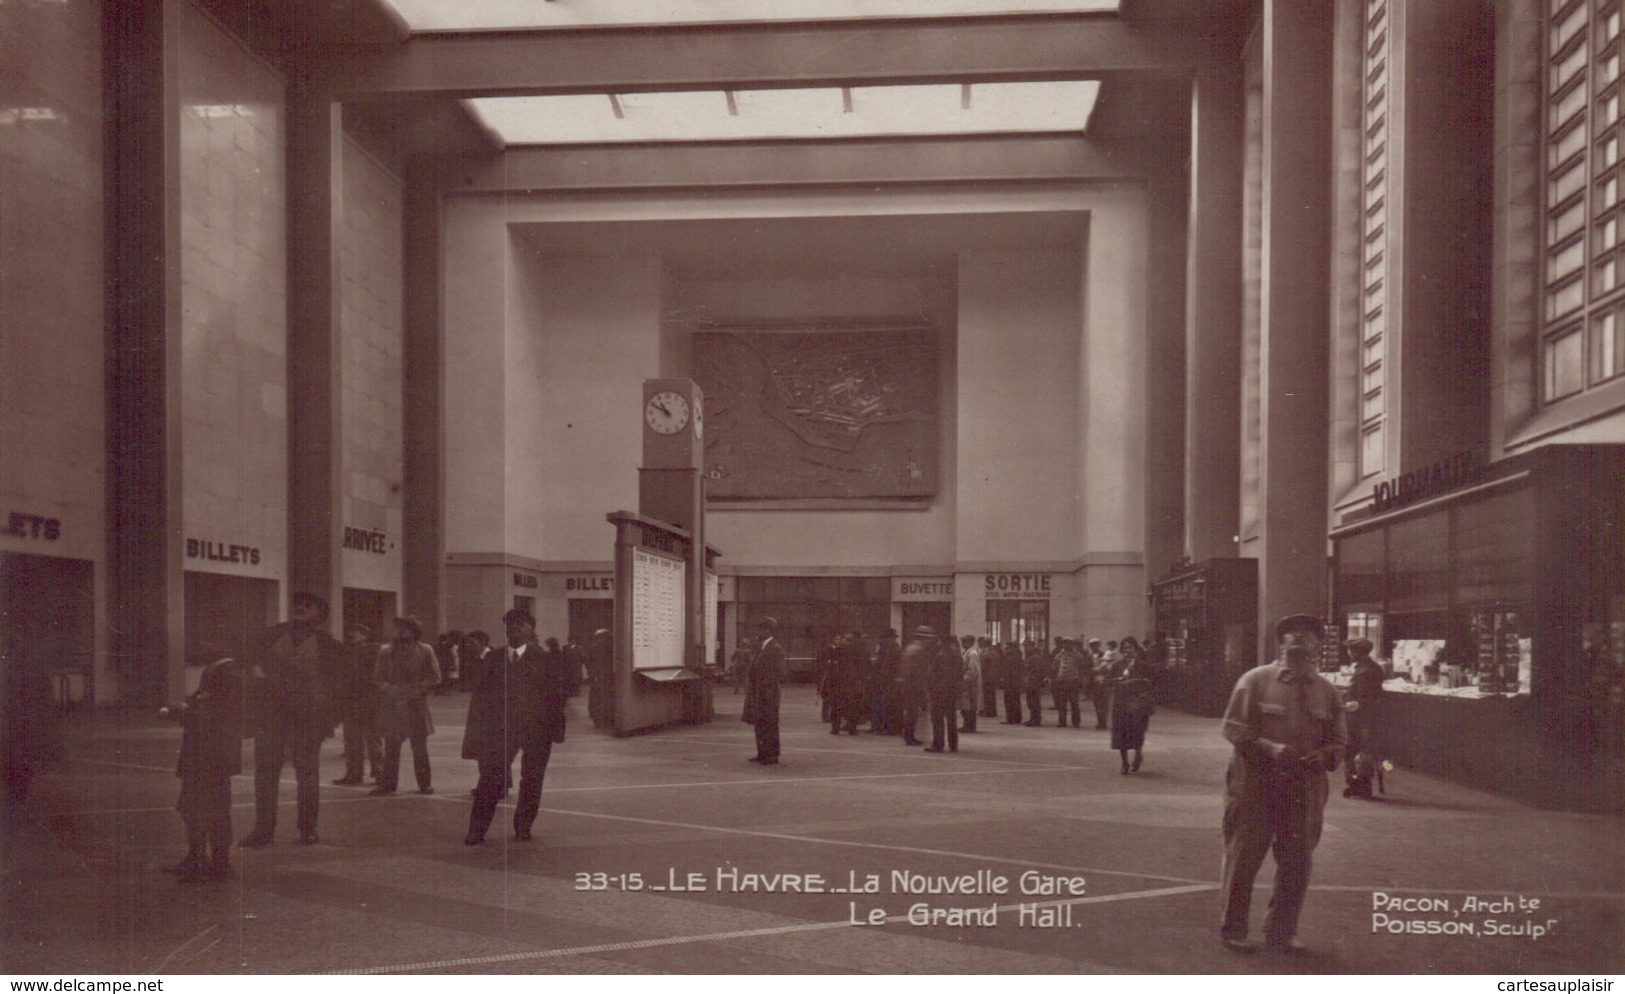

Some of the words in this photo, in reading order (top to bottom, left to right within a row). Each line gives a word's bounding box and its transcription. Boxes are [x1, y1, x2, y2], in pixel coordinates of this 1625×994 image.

[342, 526, 387, 555] ARRIVÉE
[186, 538, 260, 566] BILLETS
[900, 582, 953, 595] BUVETTE
[985, 574, 1052, 591] SORTIE
